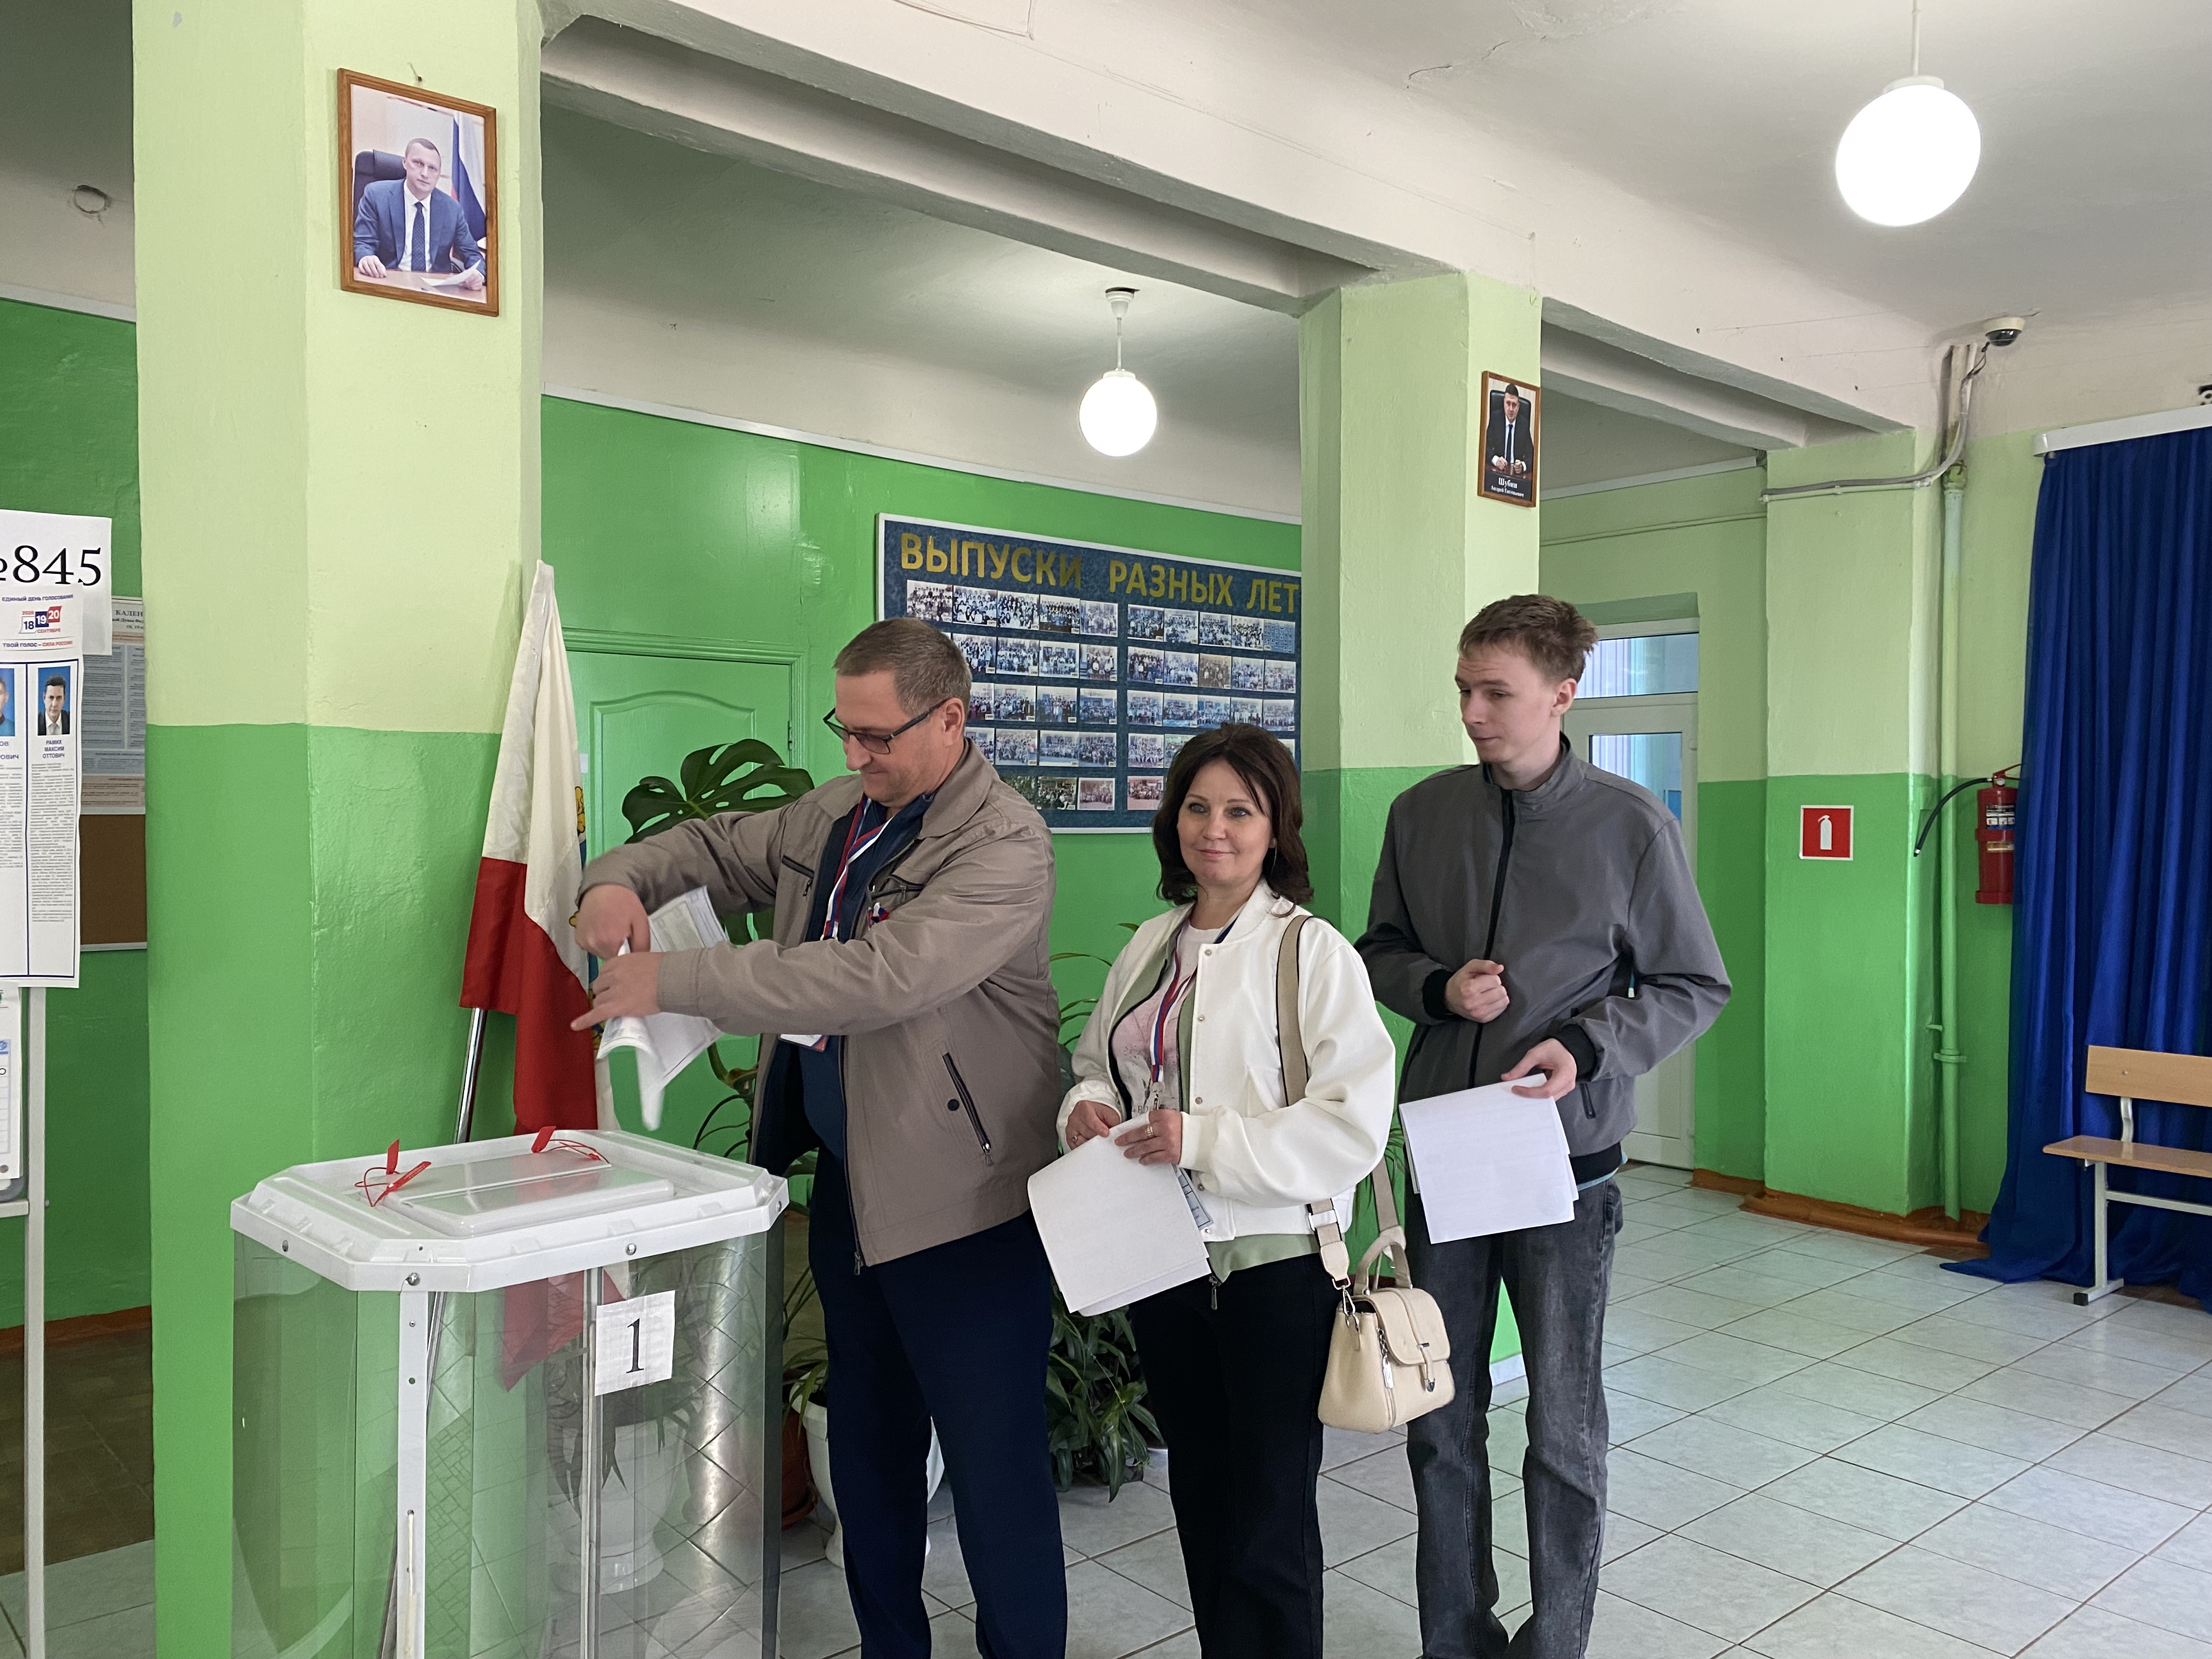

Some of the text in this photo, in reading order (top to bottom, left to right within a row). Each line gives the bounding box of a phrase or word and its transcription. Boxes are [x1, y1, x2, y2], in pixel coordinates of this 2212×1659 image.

[1498, 477, 1517, 488] Шубин
[901, 533, 1299, 613] ВЫПУСКИ РАЗНЫХ ЛЕТ
[23, 610, 59, 630] 18 19 20
